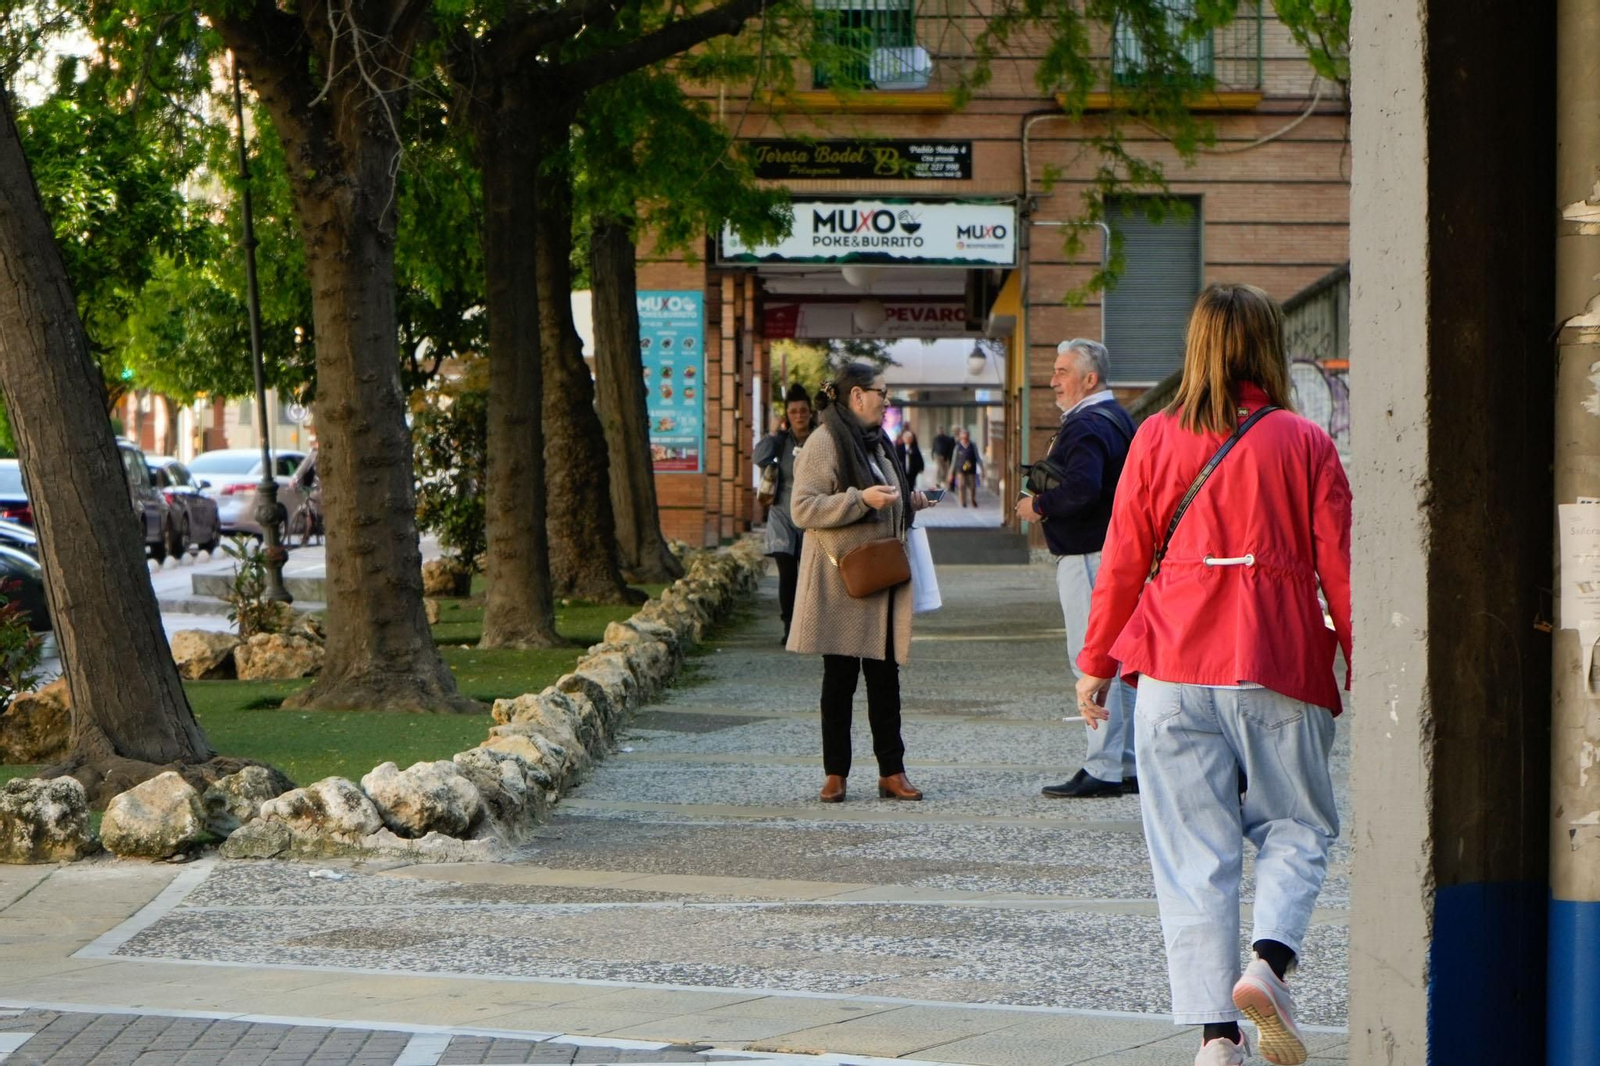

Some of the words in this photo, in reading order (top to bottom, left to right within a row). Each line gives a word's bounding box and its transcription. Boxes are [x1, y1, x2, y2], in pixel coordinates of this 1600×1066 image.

[757, 146, 807, 163] Teresa
[814, 145, 865, 163] Bodel
[813, 209, 895, 233] MUXO
[957, 225, 1006, 239] MUXO
[813, 236, 923, 247] POKE&BURRITO
[637, 297, 682, 311] MUXO
